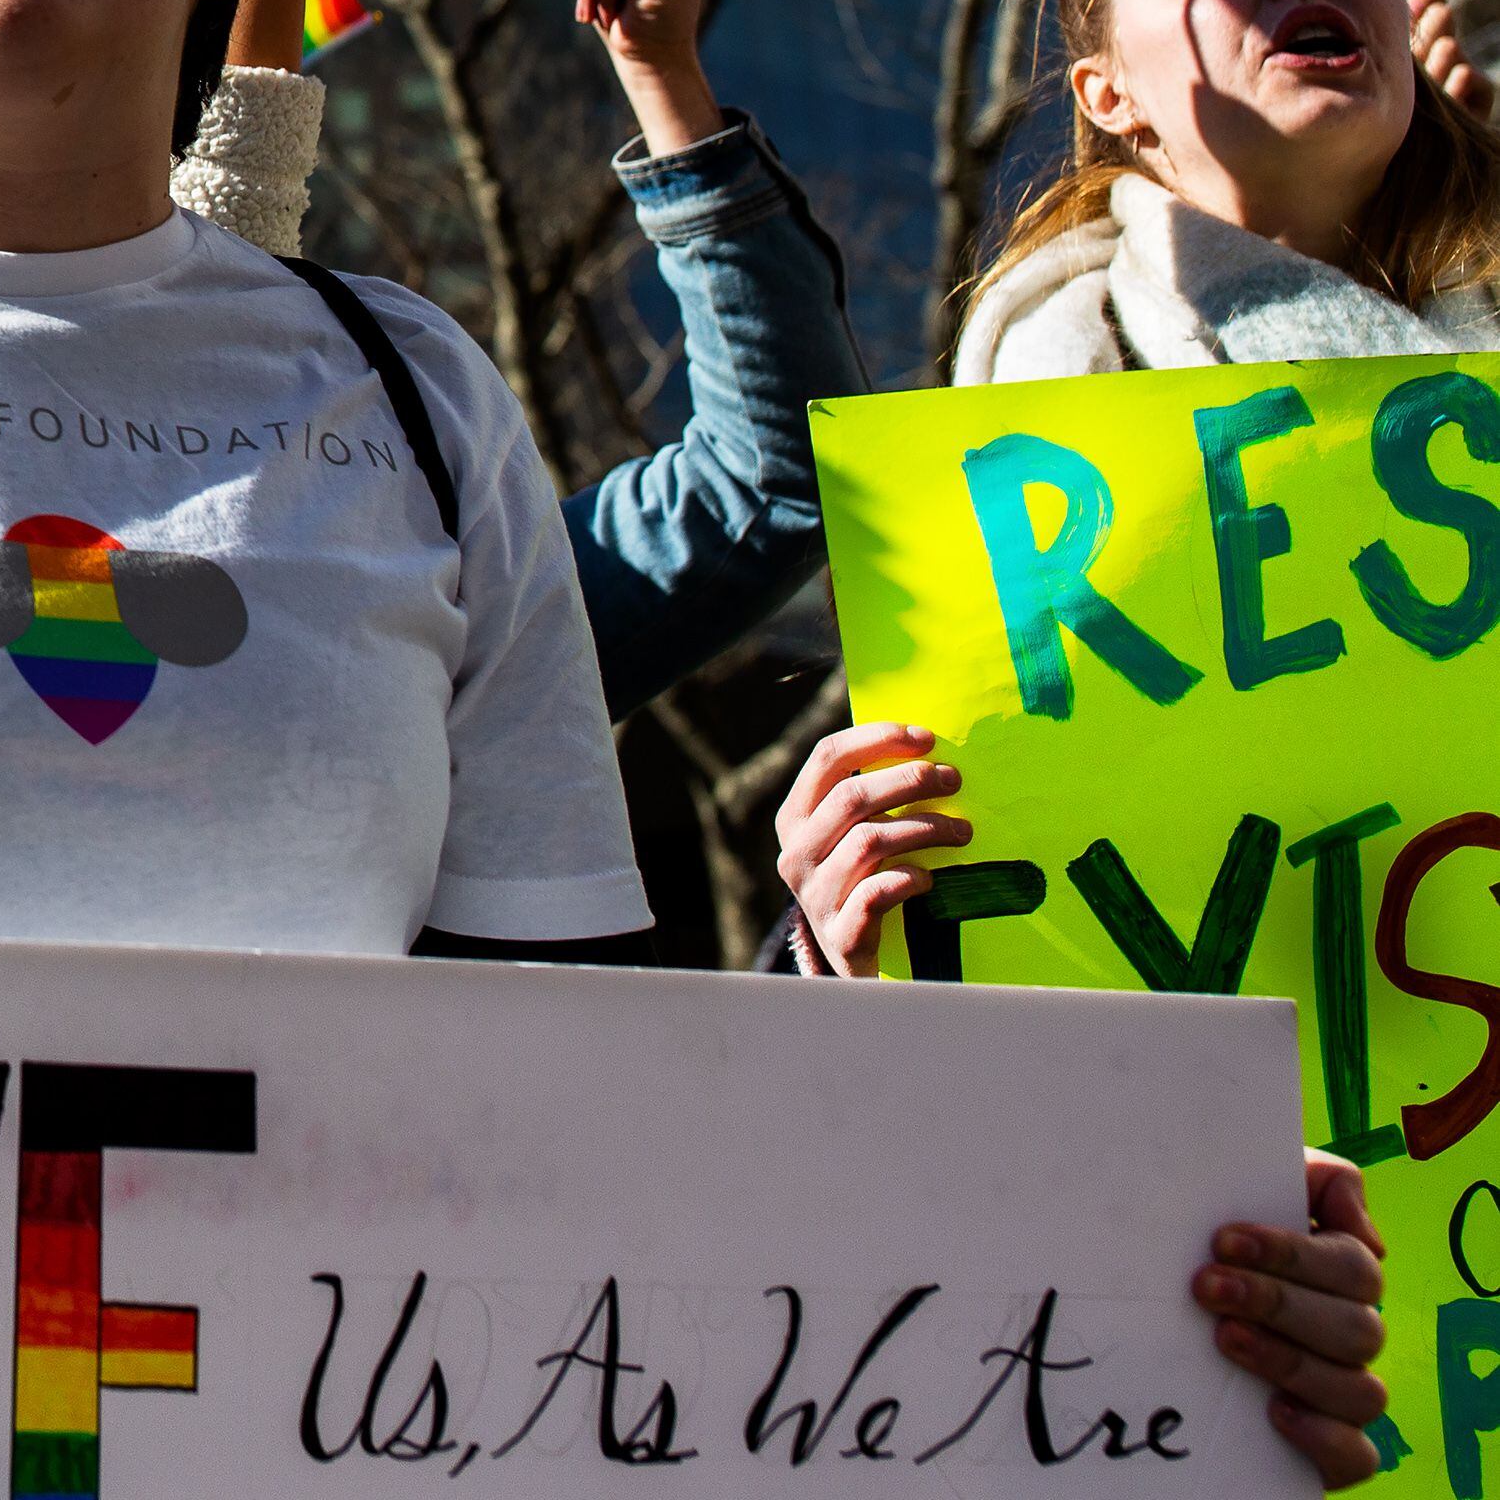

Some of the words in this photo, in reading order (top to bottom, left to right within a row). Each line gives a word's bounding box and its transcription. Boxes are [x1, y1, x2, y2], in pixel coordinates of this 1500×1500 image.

[961, 370, 1500, 722] RES
[300, 1269, 480, 1478] Us,
[492, 1274, 700, 1464] As
[743, 1283, 941, 1468] We
[914, 1286, 1191, 1467] Are
